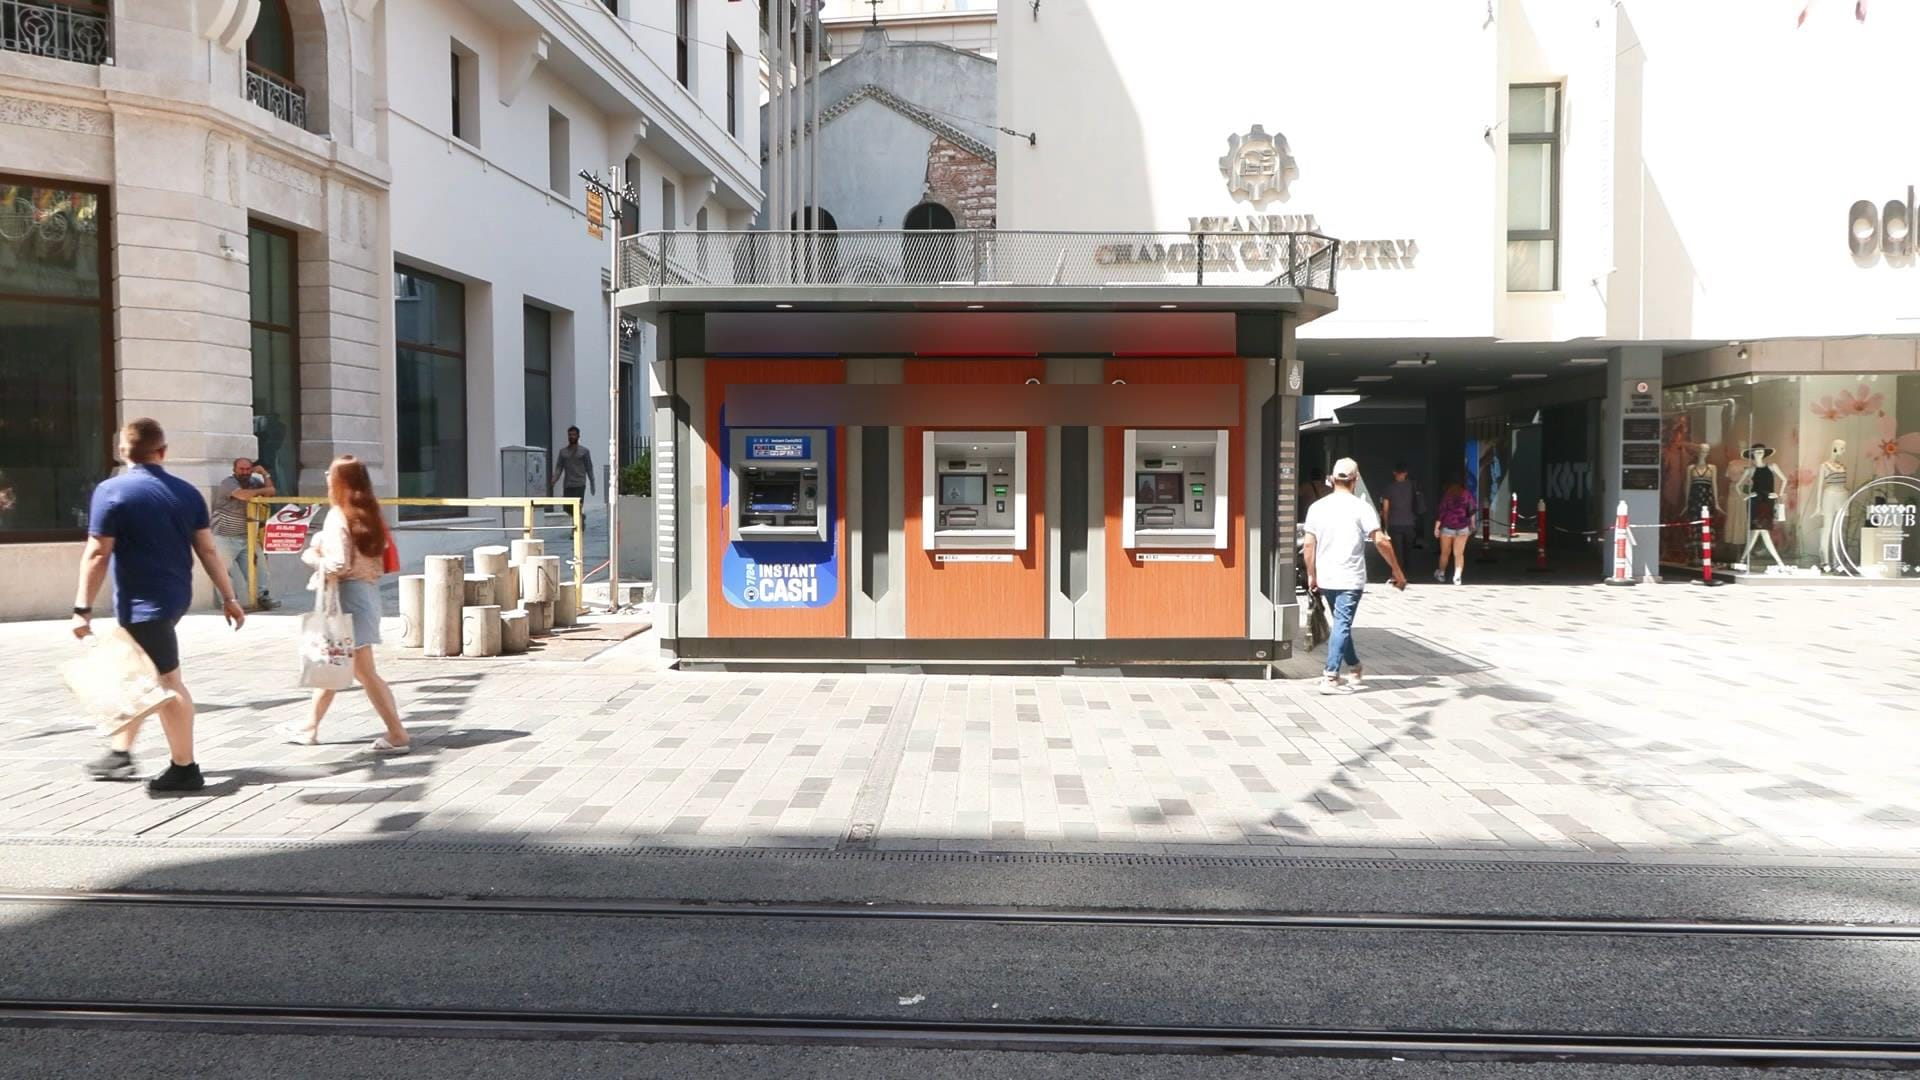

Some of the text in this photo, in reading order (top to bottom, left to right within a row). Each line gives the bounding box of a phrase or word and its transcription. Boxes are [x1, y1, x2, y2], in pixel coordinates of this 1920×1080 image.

[1848, 184, 1920, 260] ad
[745, 563, 756, 586] 7/24
[758, 563, 817, 578] INSTANT
[759, 578, 818, 602] CASH
